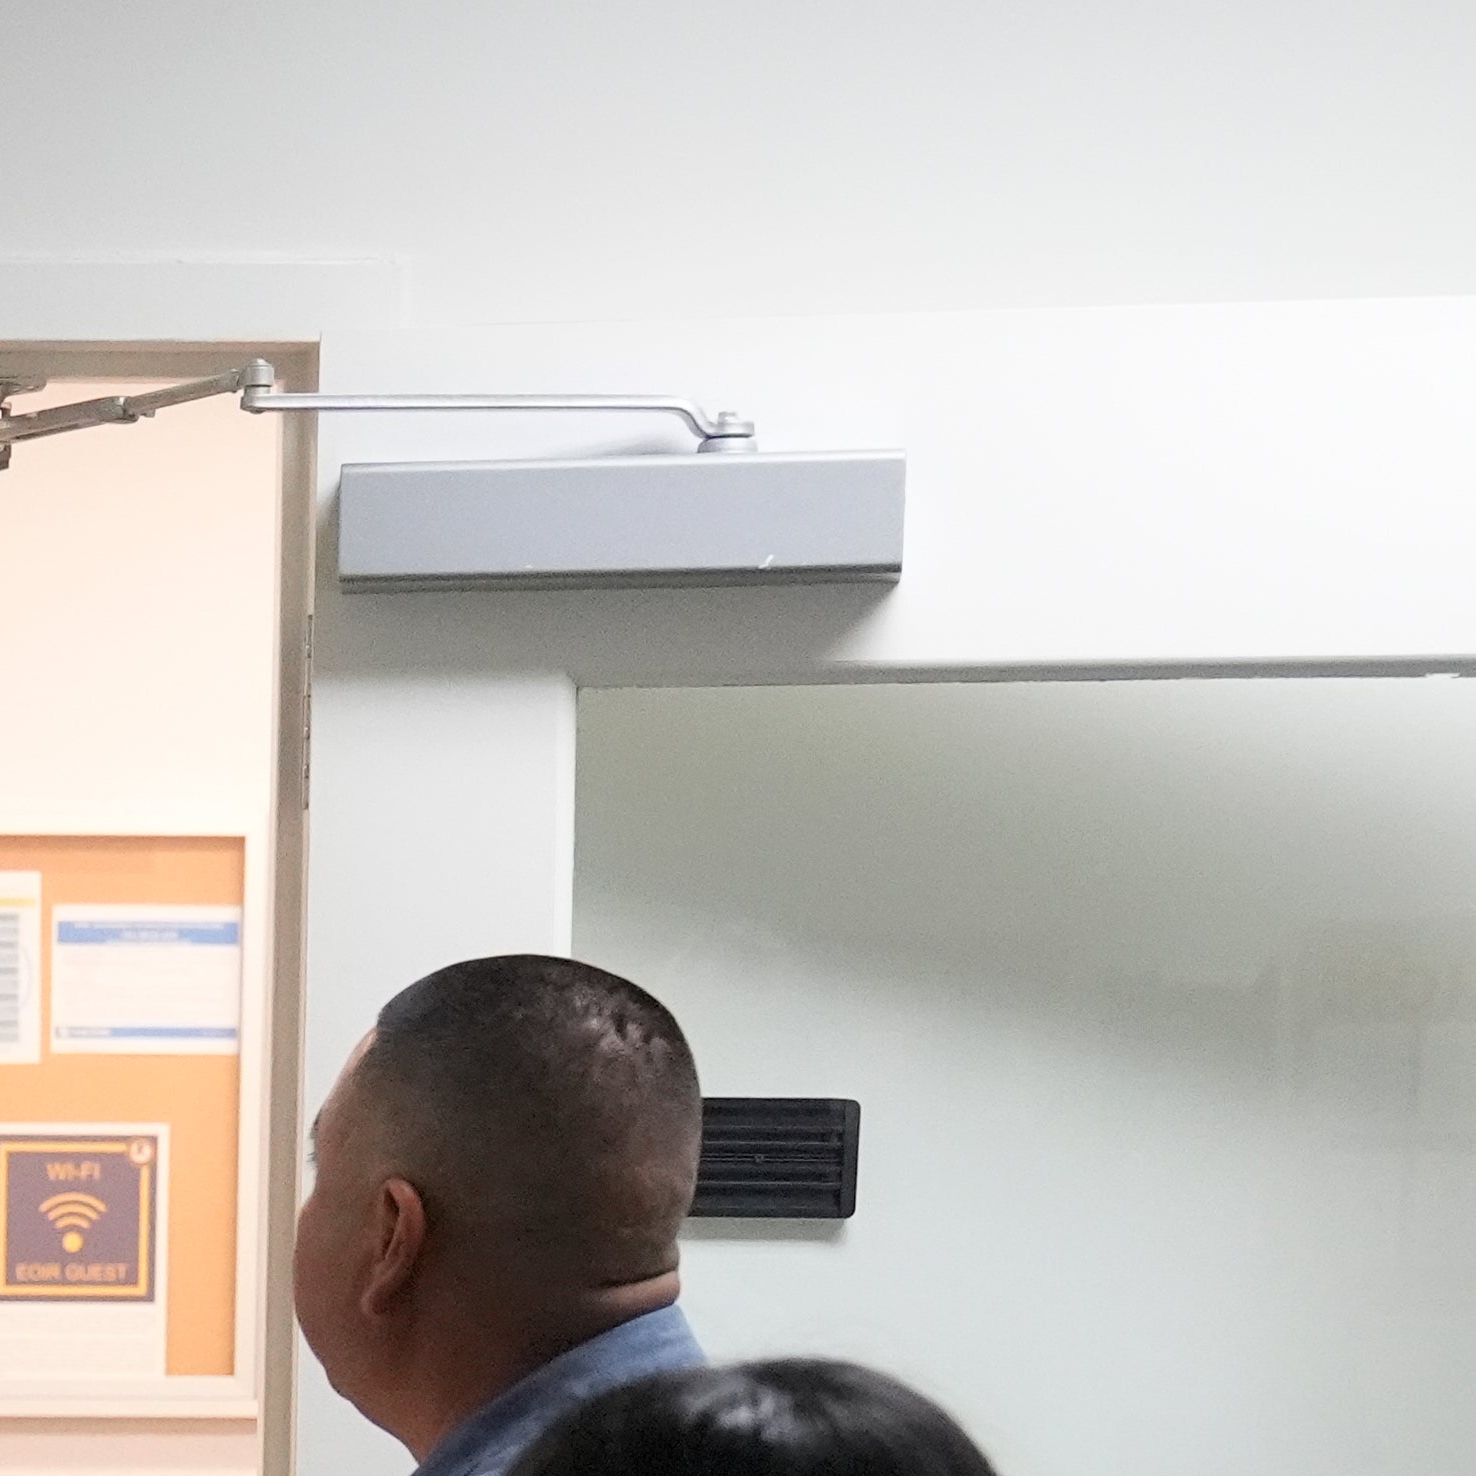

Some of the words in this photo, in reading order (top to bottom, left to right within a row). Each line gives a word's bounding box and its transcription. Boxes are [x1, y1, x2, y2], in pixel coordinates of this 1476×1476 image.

[46, 1162, 101, 1181] WI-FI
[15, 1262, 61, 1281] EOIR
[64, 1262, 127, 1281] GUEST
